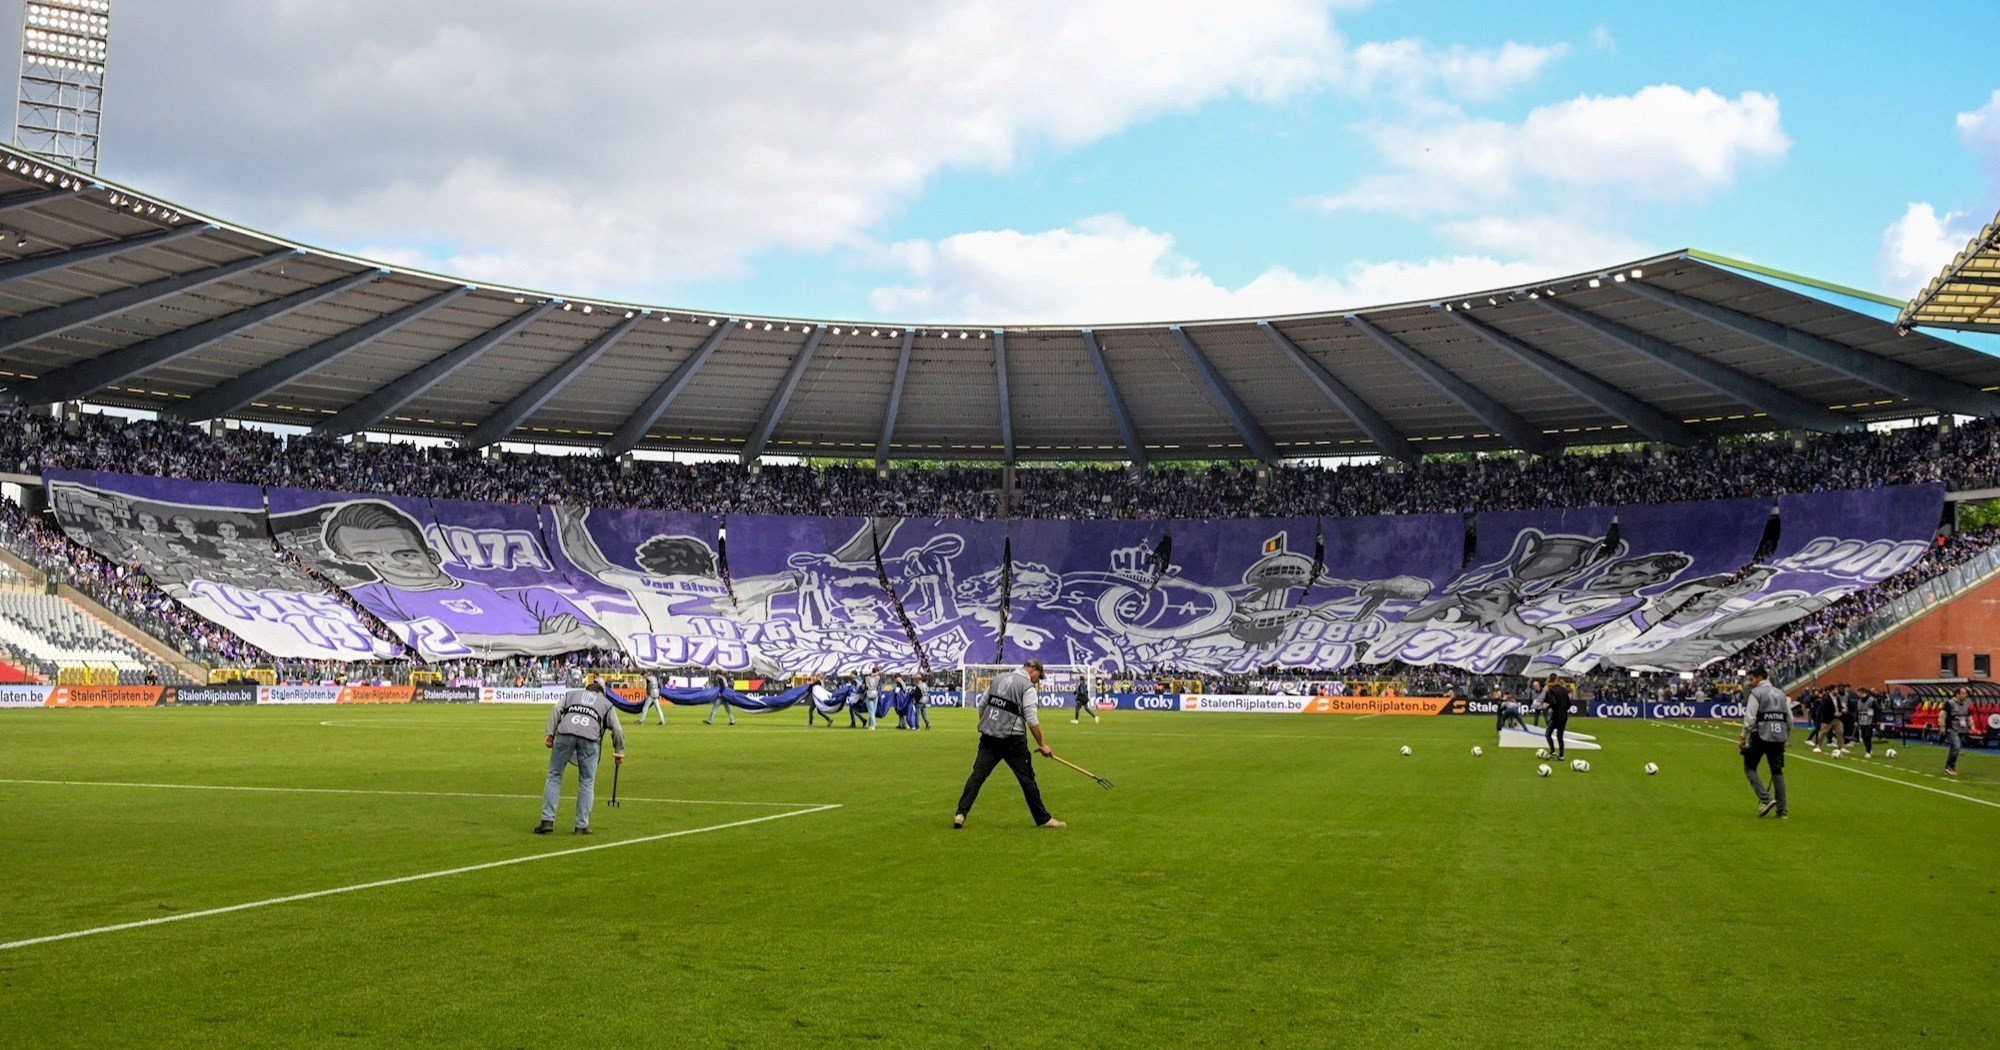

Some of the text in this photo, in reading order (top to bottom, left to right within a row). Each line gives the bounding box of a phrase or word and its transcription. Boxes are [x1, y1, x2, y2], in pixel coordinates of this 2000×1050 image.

[629, 634, 750, 668] 1975
[70, 690, 155, 704] StalenRijplaten.be
[177, 690, 252, 703] StalenRijplaten.be
[271, 690, 336, 702] StalenRijplaten.be
[352, 690, 409, 702] StalenRijplaten.be
[424, 690, 476, 702] StalenRijplaten.be
[930, 693, 958, 706] roky
[1134, 694, 1173, 710] Croky
[1200, 698, 1302, 710] StalenRijplaten.be
[1332, 699, 1437, 712] StalenRijplaten.be
[1596, 702, 1638, 718] Croky
[1653, 702, 1695, 718] Croky
[1710, 702, 1746, 718] Crok
[571, 715, 590, 726] 68
[988, 708, 999, 720] 12
[1770, 722, 1782, 733] 18
